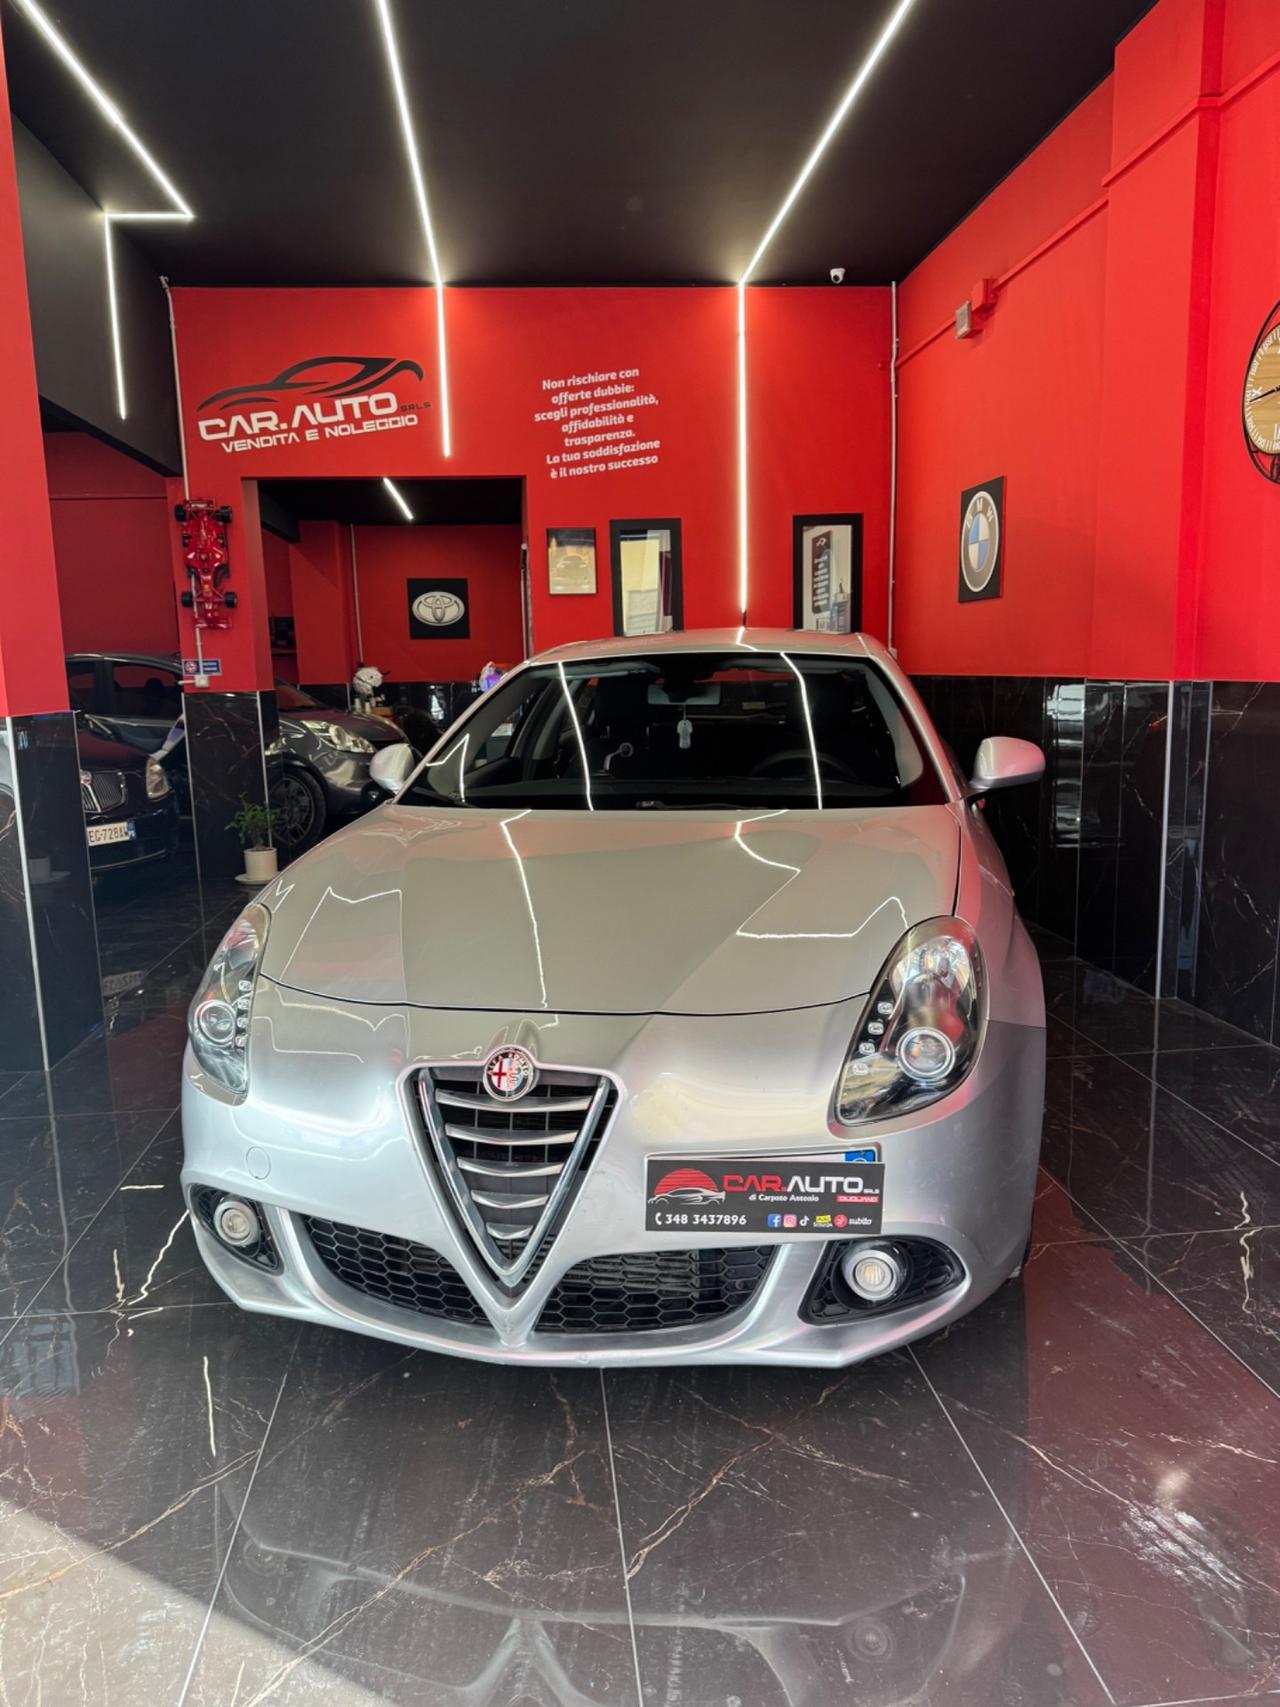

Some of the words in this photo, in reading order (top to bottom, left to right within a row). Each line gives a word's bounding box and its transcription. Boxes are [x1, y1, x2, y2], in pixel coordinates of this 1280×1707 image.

[542, 379, 565, 390] Non
[567, 370, 617, 387] rischiare
[619, 368, 639, 379] con
[551, 390, 592, 405] offerte
[594, 383, 635, 398] dubbie:
[198, 392, 397, 441] CAR.AUTO
[534, 407, 568, 421] scegli
[570, 394, 659, 418] professionalità,
[222, 433, 300, 453] VENDITA
[305, 428, 320, 441] E
[325, 414, 418, 438] NOLEGGIO
[561, 415, 625, 433] affidabilità
[626, 413, 634, 423] e
[564, 429, 636, 447] trasparenza.
[546, 454, 560, 465] La
[562, 451, 580, 462] tua
[582, 439, 661, 459] soddisfazione
[550, 468, 557, 479] è
[559, 466, 567, 478] il
[569, 462, 606, 476] nostro
[607, 455, 659, 471] successo
[723, 1175, 864, 1193] CAR.AUTO
[665, 1214, 689, 1225] 348
[692, 1214, 747, 1225] 3437896
